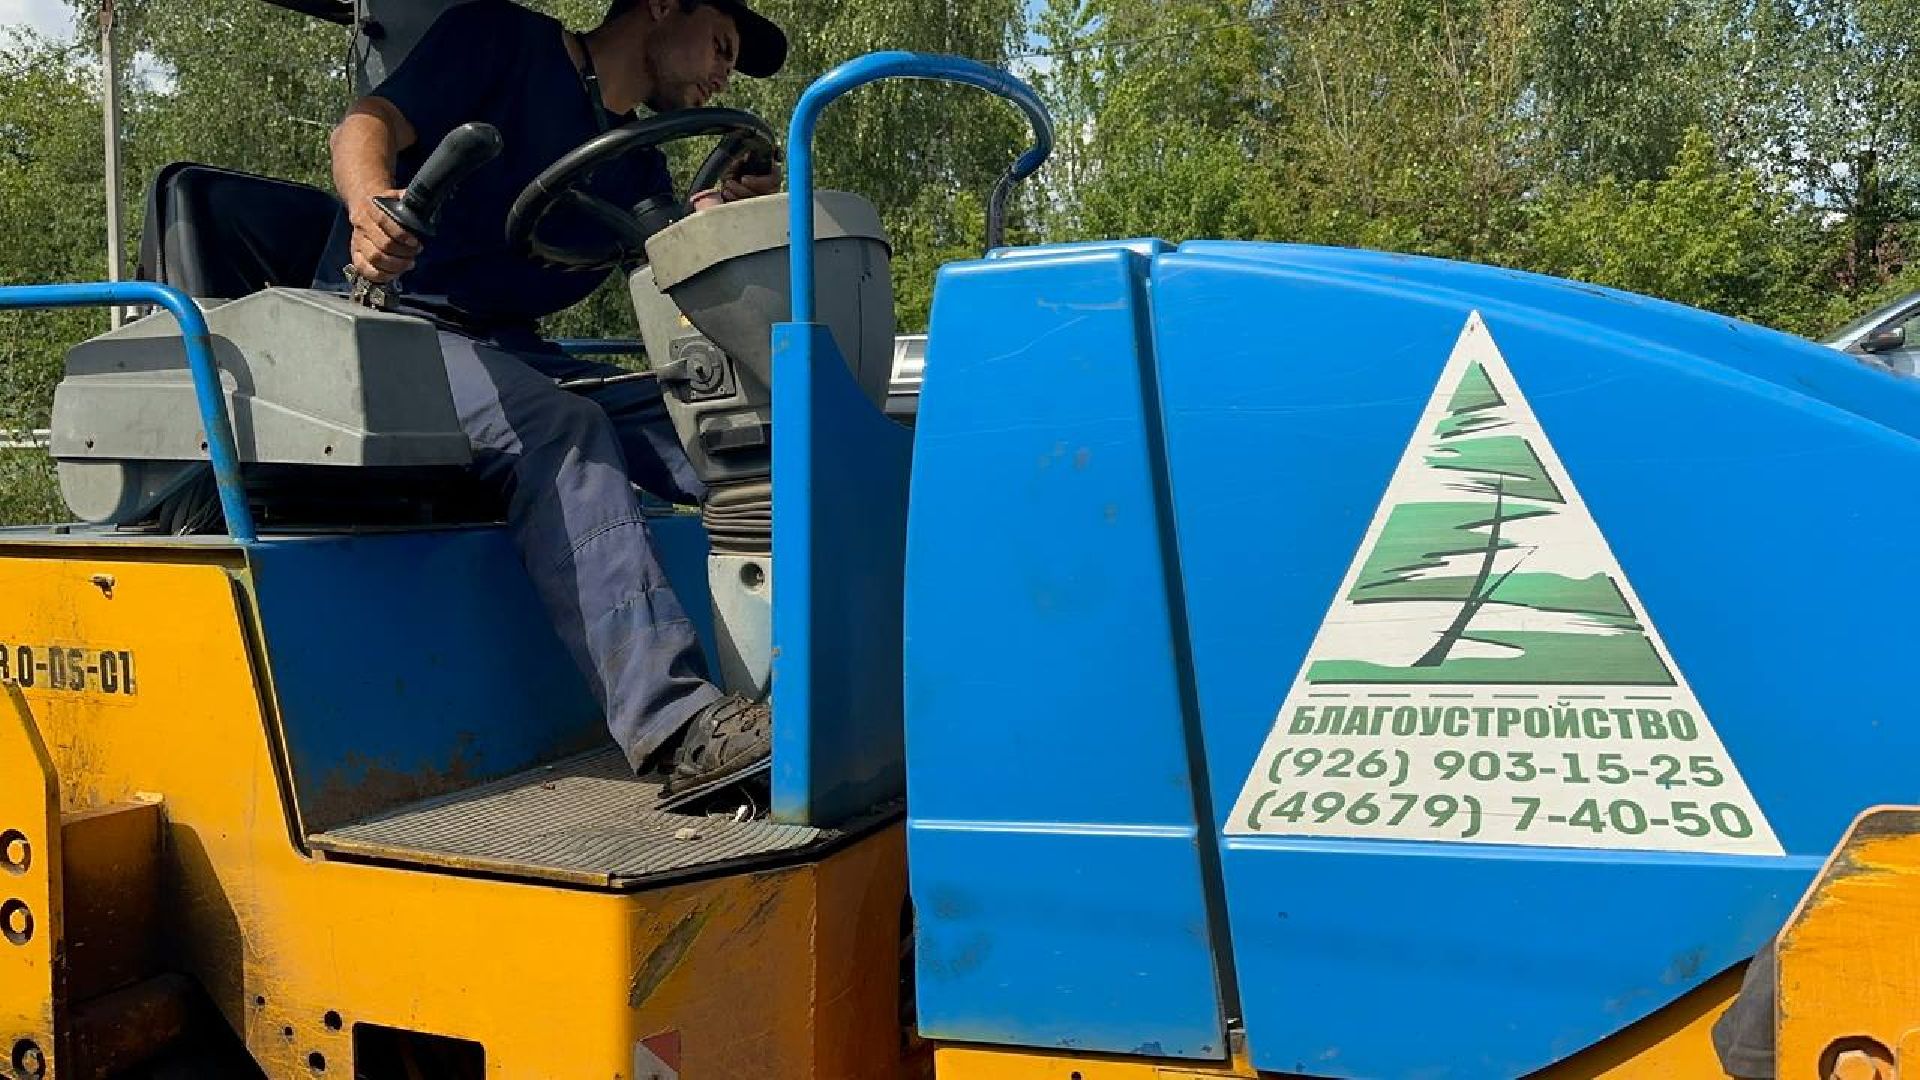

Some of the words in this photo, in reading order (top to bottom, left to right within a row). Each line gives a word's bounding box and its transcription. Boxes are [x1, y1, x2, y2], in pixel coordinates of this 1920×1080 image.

[1288, 701, 1699, 741] БЛАГОУСТРОЙСТВО
[1268, 747, 1410, 787] (926)
[1433, 750, 1724, 788] 903-15-25
[1247, 789, 1482, 838] (49679)
[1511, 796, 1754, 839] 7-40-50
